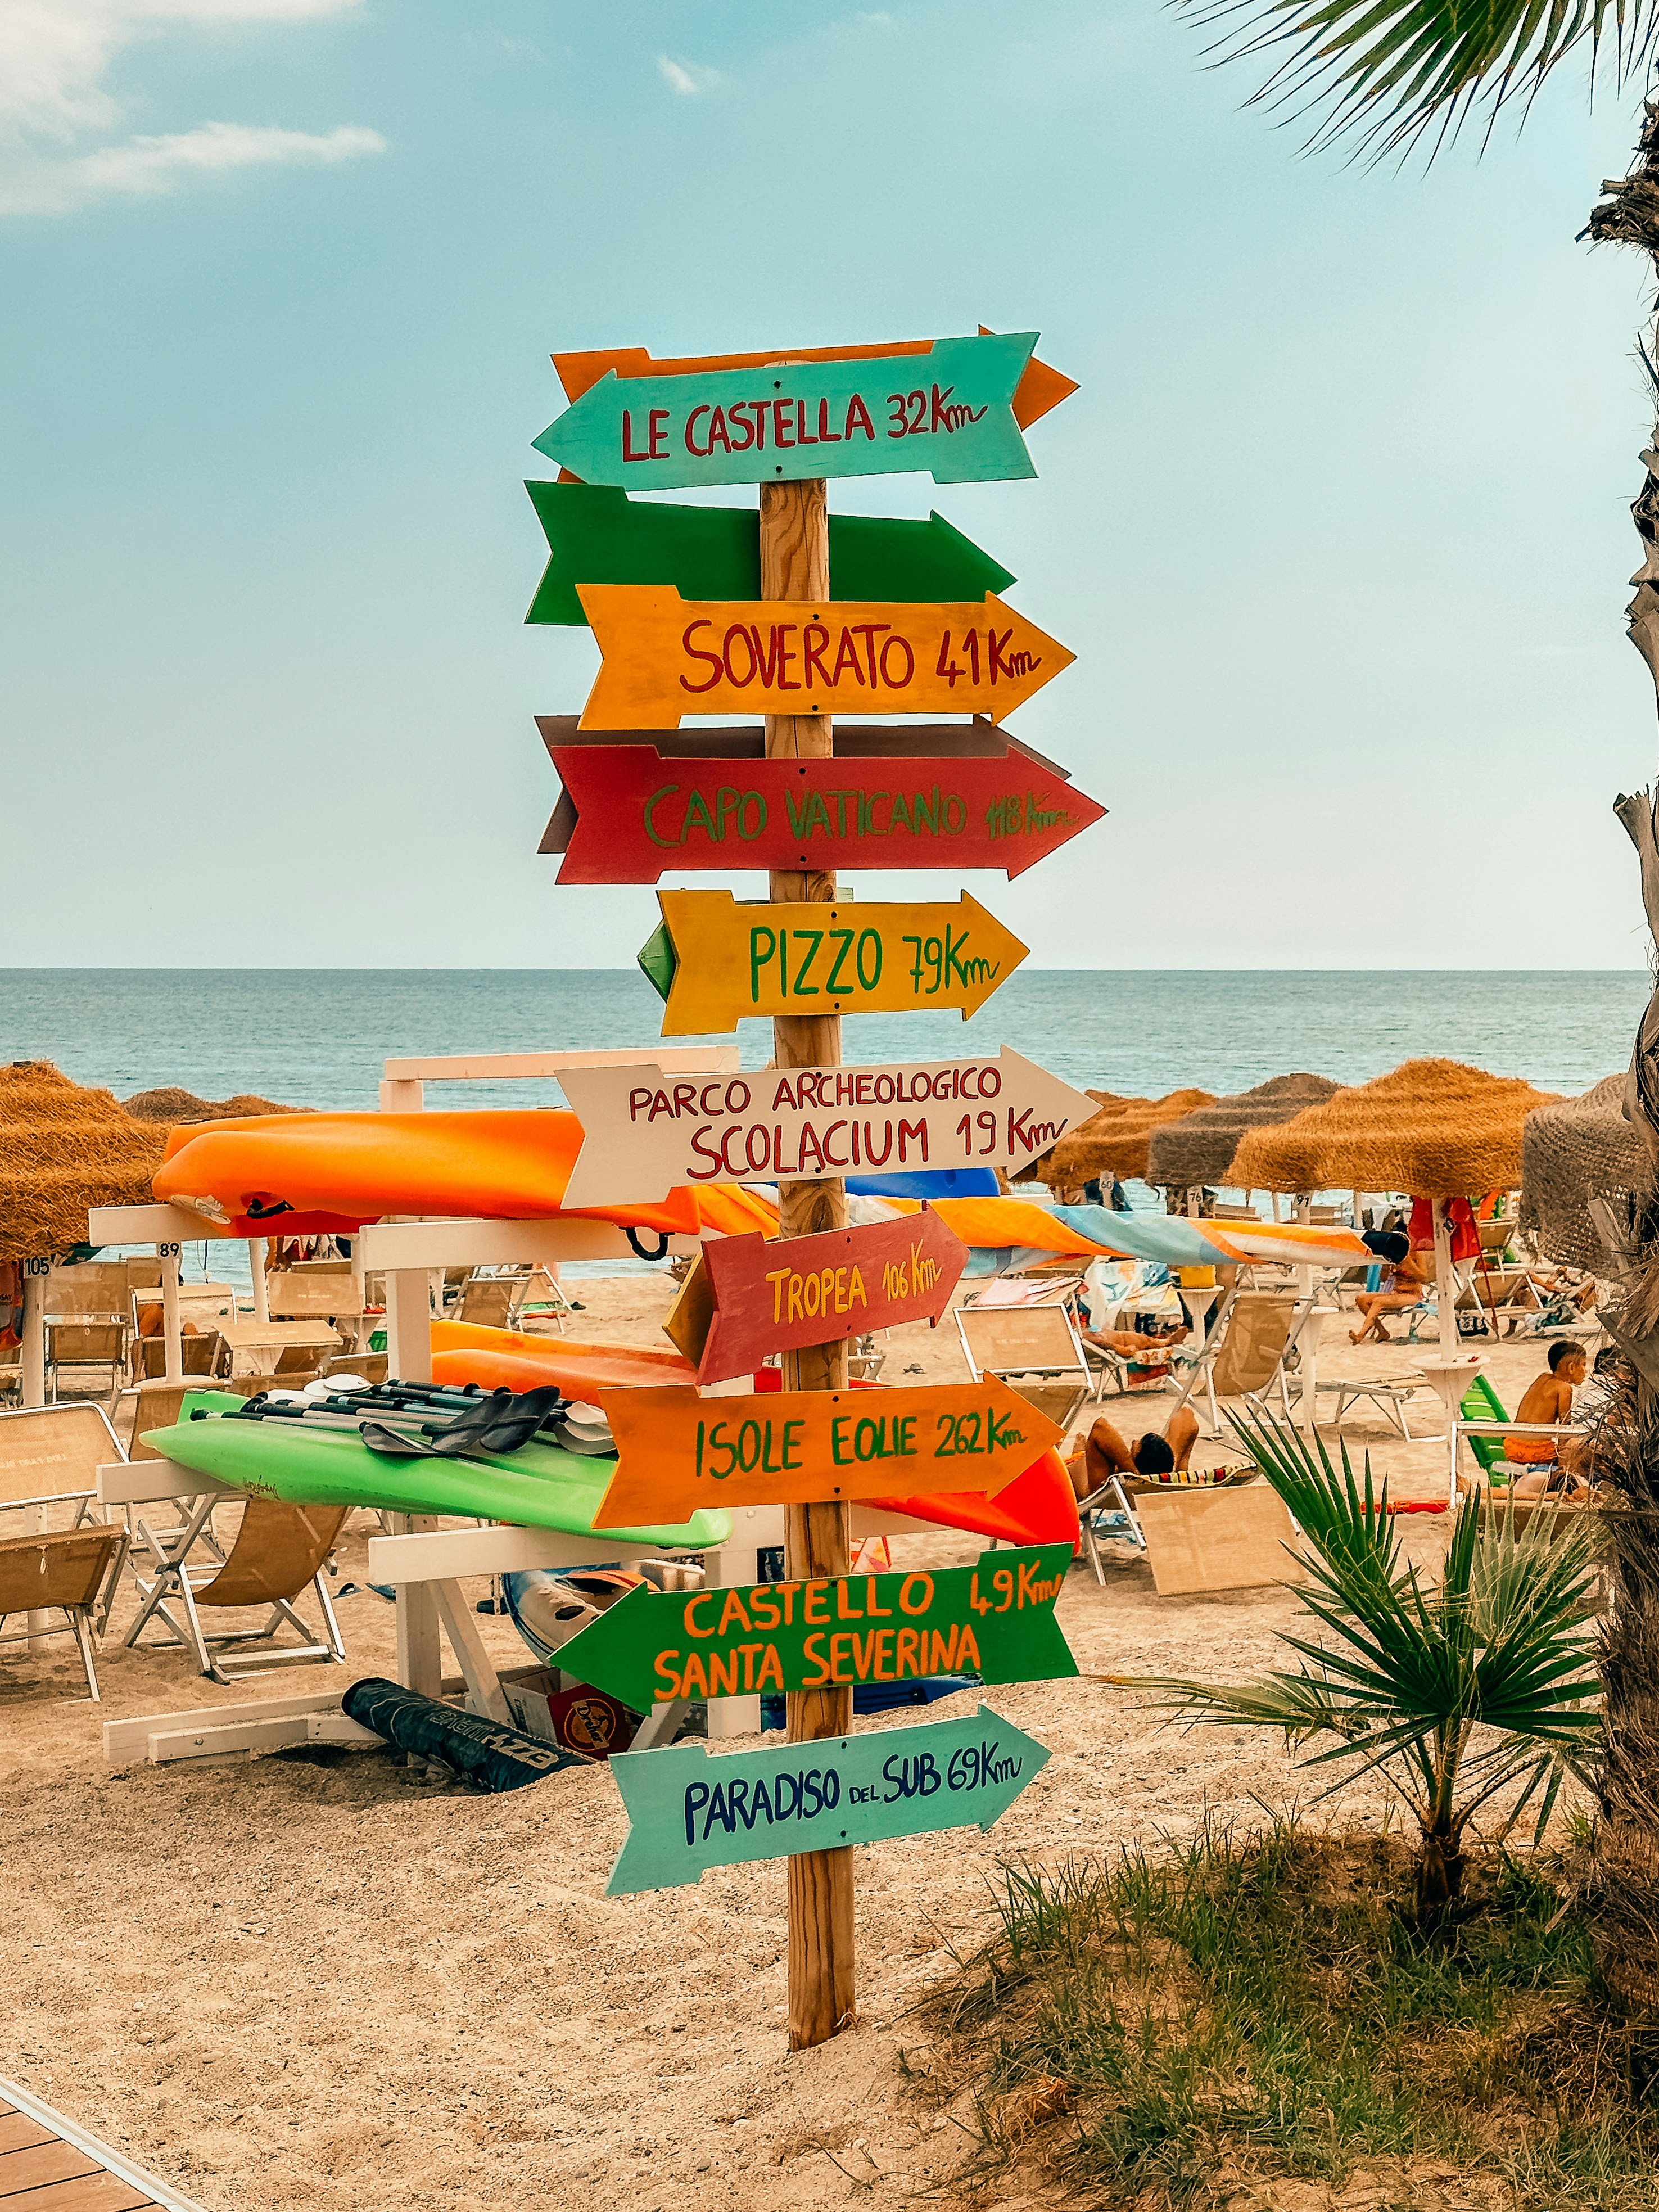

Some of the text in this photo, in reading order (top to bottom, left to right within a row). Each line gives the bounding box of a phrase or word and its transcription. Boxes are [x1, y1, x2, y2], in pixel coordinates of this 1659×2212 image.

[623, 409, 670, 462] LE
[685, 394, 875, 457] CASTELLA
[680, 620, 914, 693] SOVERATO
[645, 786, 766, 846] CAPO
[786, 786, 965, 839] VATICANO
[751, 927, 882, 1003] PIZZO
[630, 1066, 1001, 1122] PARCO ARCHEOLOGICO
[687, 1117, 929, 1179] SCOLACIUM
[1189, 1193, 1202, 1203] 76
[1296, 1194, 1309, 1207] 91
[24, 1257, 50, 1276] 105
[160, 1242, 179, 1257] 89
[765, 1264, 868, 1325] TROPEA
[697, 1420, 804, 1479] ISOLE
[832, 1416, 917, 1465] EOLIE
[683, 1572, 935, 1638] CASTELLO
[654, 1623, 982, 1701] SANTA SEVERINA
[576, 1705, 605, 1743] Dreher
[685, 1769, 840, 1847] PARADISO
[849, 1785, 880, 1804] DEL
[883, 1753, 941, 1803] SUB
